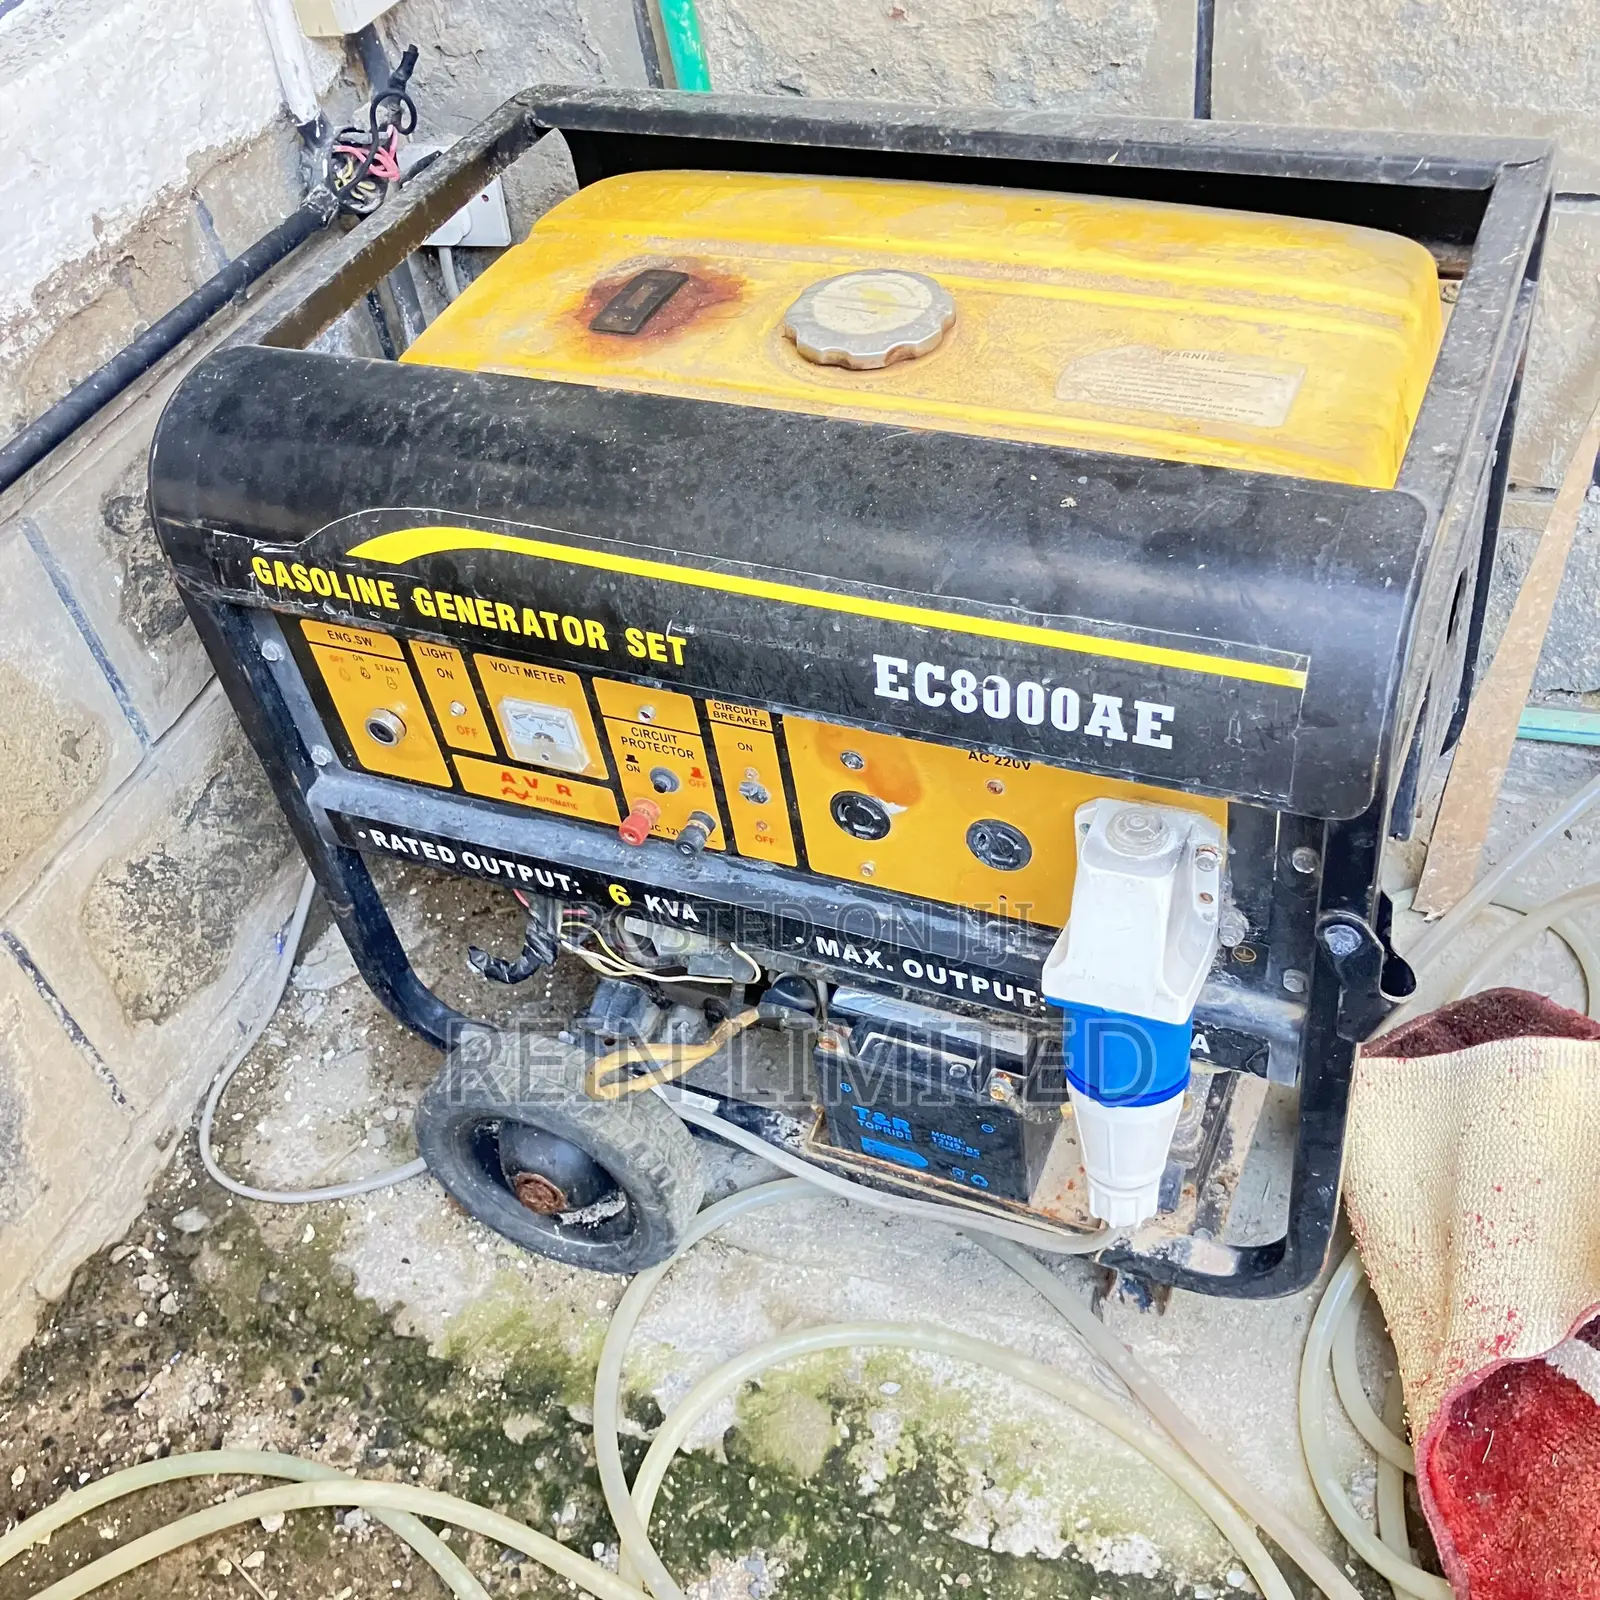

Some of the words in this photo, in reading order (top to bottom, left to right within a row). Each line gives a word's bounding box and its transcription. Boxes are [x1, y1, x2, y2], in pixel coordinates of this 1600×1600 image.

[1160, 350, 1226, 363] WARNING
[251, 556, 400, 610] GASOLINE
[413, 587, 609, 651] GENERATOR
[624, 627, 687, 666] SET
[352, 654, 365, 662] ON
[419, 646, 454, 662] LIGHT
[374, 663, 401, 674] START
[436, 668, 455, 680] ON
[490, 661, 521, 676] VOLT
[524, 667, 566, 685] METER
[713, 702, 759, 717] CIRCUIT
[872, 653, 1175, 750] EC8000AE
[712, 711, 768, 728] BREAKER
[456, 725, 478, 738] OFF
[631, 726, 678, 745] CIRCUIT
[621, 736, 696, 760] PROTECTOR
[737, 742, 753, 752] ON
[626, 764, 641, 773] ON
[968, 751, 990, 763] AC
[994, 754, 1031, 771] 220V
[688, 778, 708, 789] OFF
[755, 834, 775, 845] OFF
[370, 829, 456, 865] RATED
[461, 850, 583, 895] OUTPUT:
[608, 885, 632, 907] 6
[644, 894, 700, 923] KVA
[816, 936, 894, 972] MAX.
[902, 958, 1046, 1011] OUTPUT:
[853, 1105, 912, 1134] T&R
[857, 1118, 913, 1141] TOPRIDE
